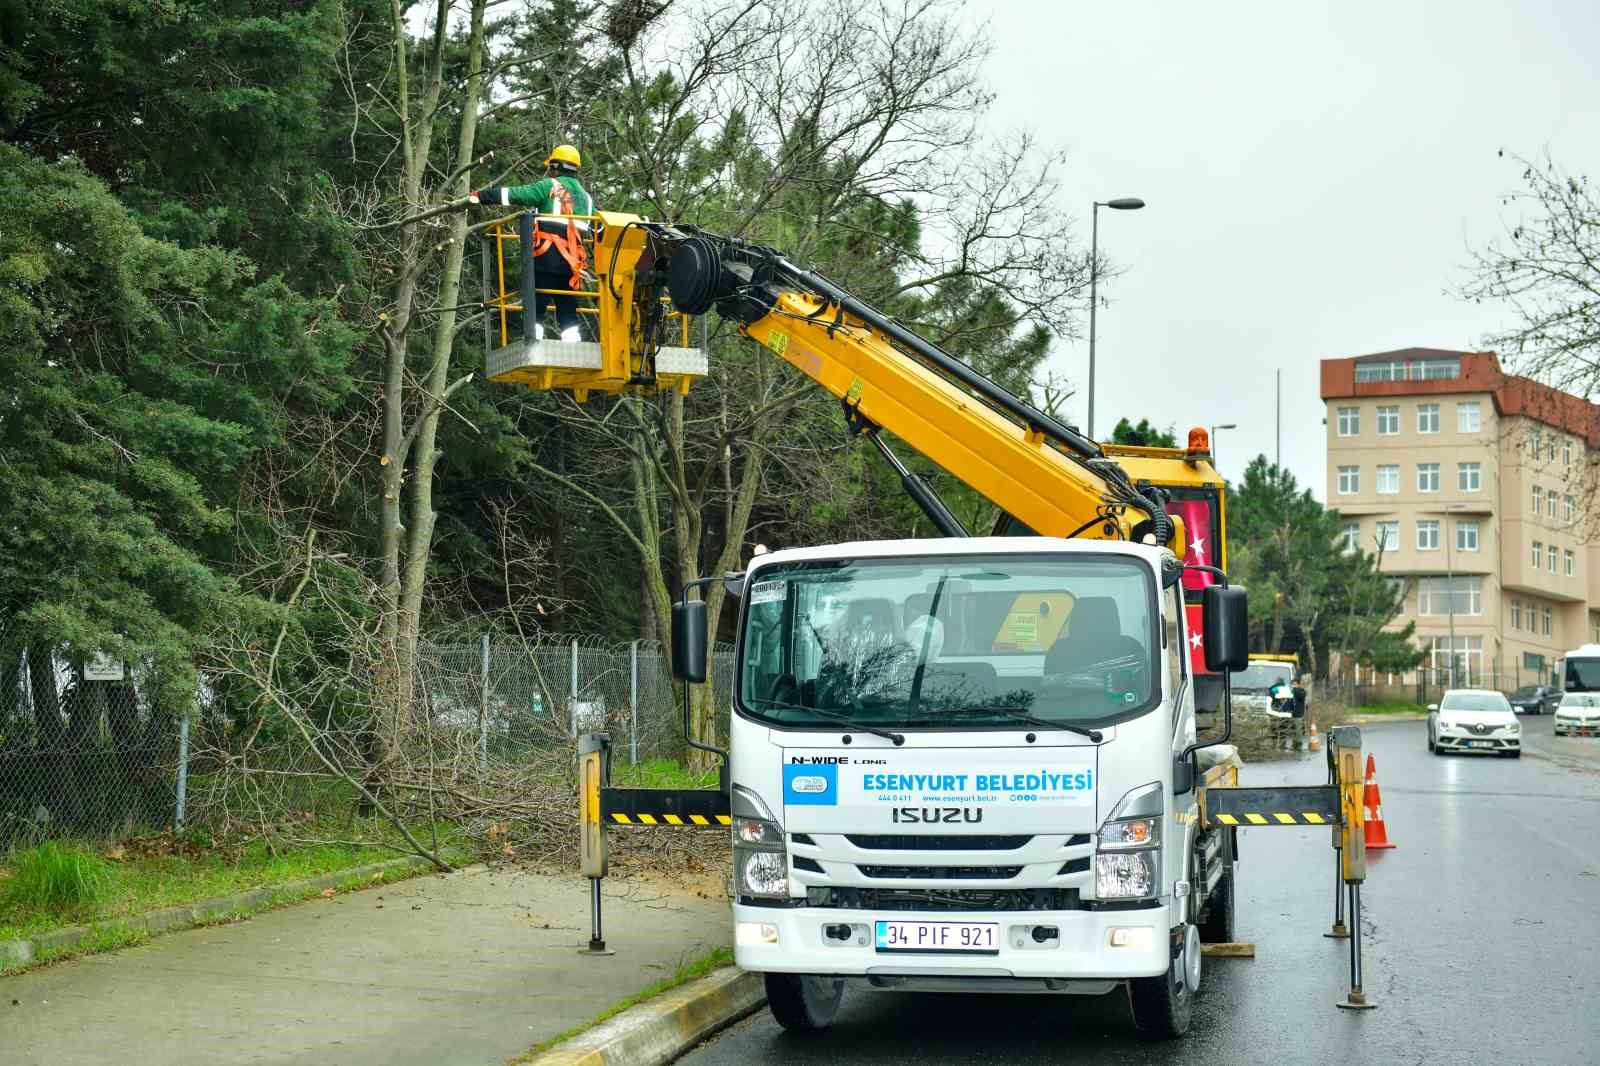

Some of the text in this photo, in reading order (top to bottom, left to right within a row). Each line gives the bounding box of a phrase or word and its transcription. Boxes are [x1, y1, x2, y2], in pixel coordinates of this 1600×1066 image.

[792, 756, 848, 765] N-WIDE
[864, 769, 1092, 791] ESENYURT BELEDİYESİ
[892, 807, 982, 823] ISUZU
[888, 926, 992, 946] 34 PIF 921
